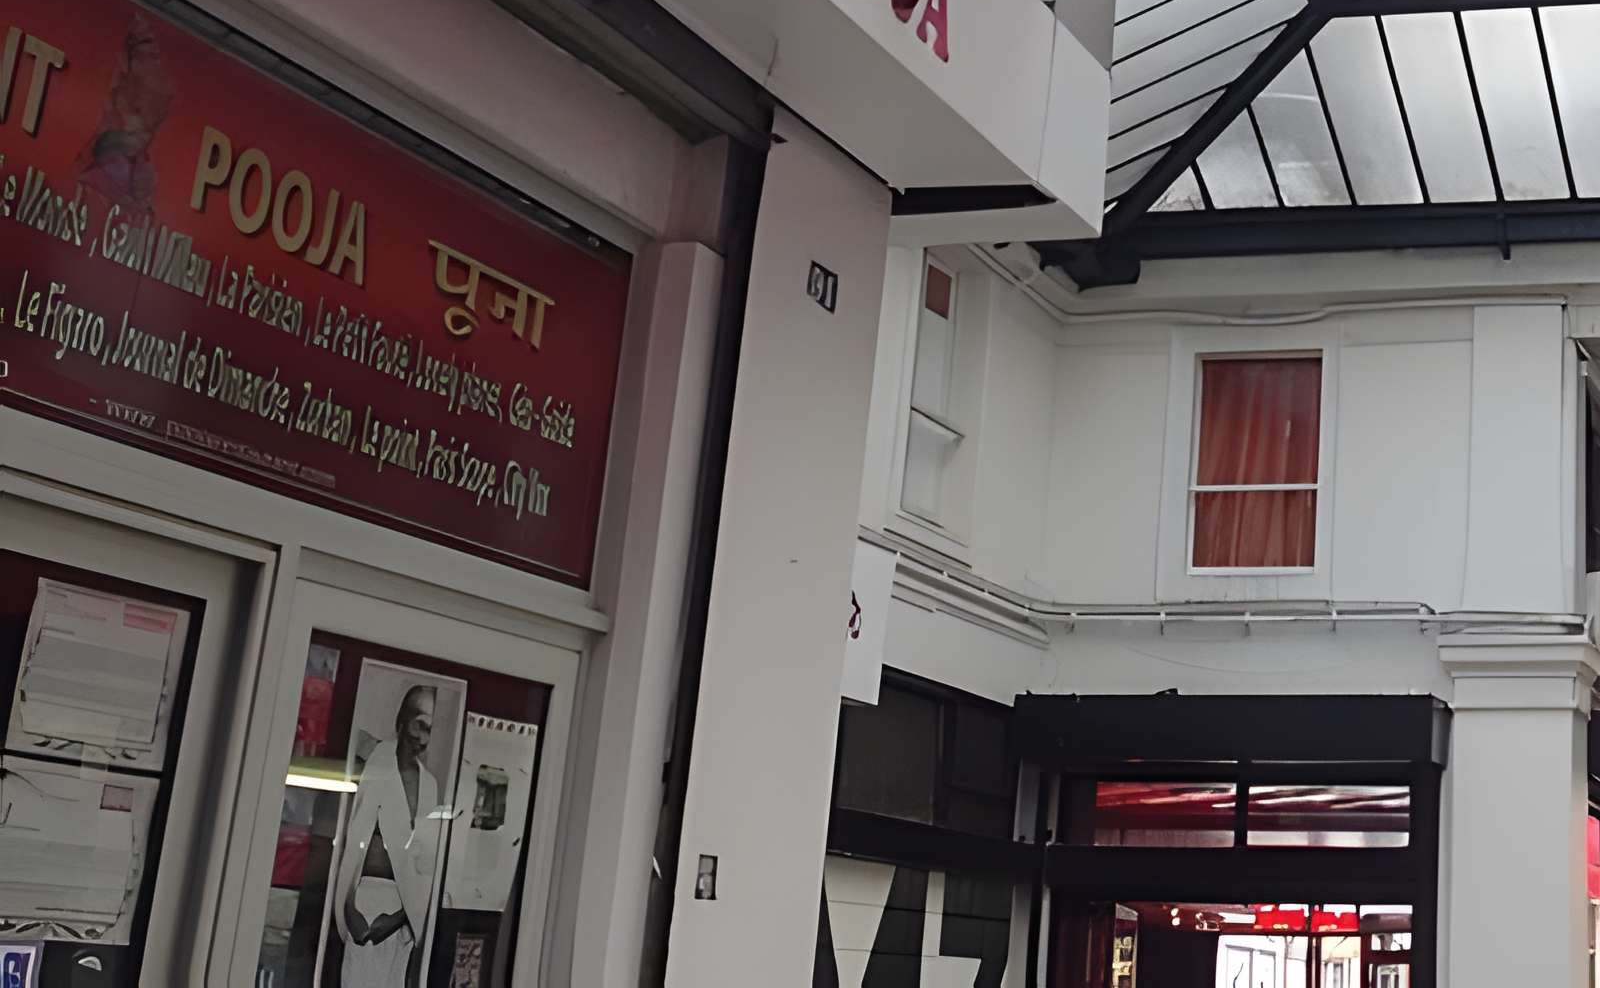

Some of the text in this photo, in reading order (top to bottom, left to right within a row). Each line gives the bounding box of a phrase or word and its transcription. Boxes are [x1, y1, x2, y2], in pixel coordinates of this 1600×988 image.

[190, 125, 366, 287] POOJA
[14, 270, 41, 332] Le
[183, 336, 207, 393] de
[428, 239, 556, 350] पूजा
